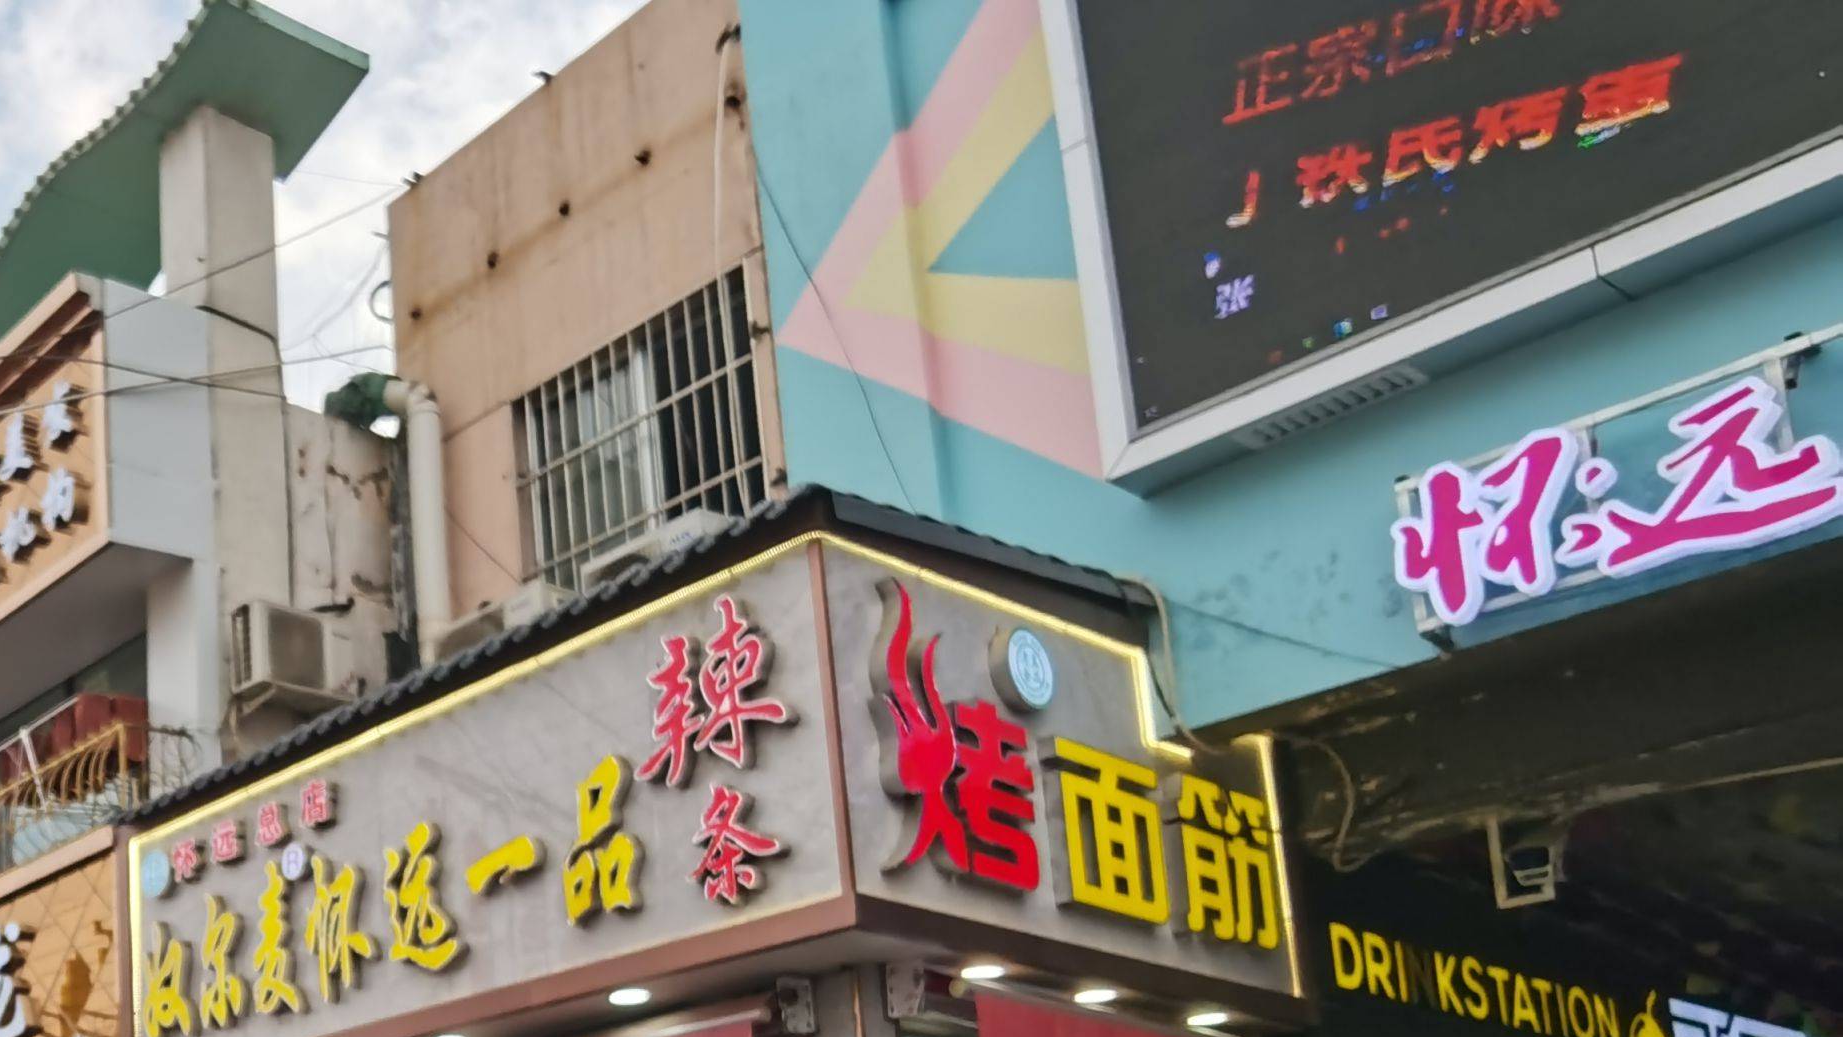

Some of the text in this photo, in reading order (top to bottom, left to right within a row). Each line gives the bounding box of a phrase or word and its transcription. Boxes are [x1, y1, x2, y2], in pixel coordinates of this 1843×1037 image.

[172, 779, 328, 883] 怀远总店
[637, 594, 786, 903] 辣条
[882, 577, 1278, 949] 烤面筋
